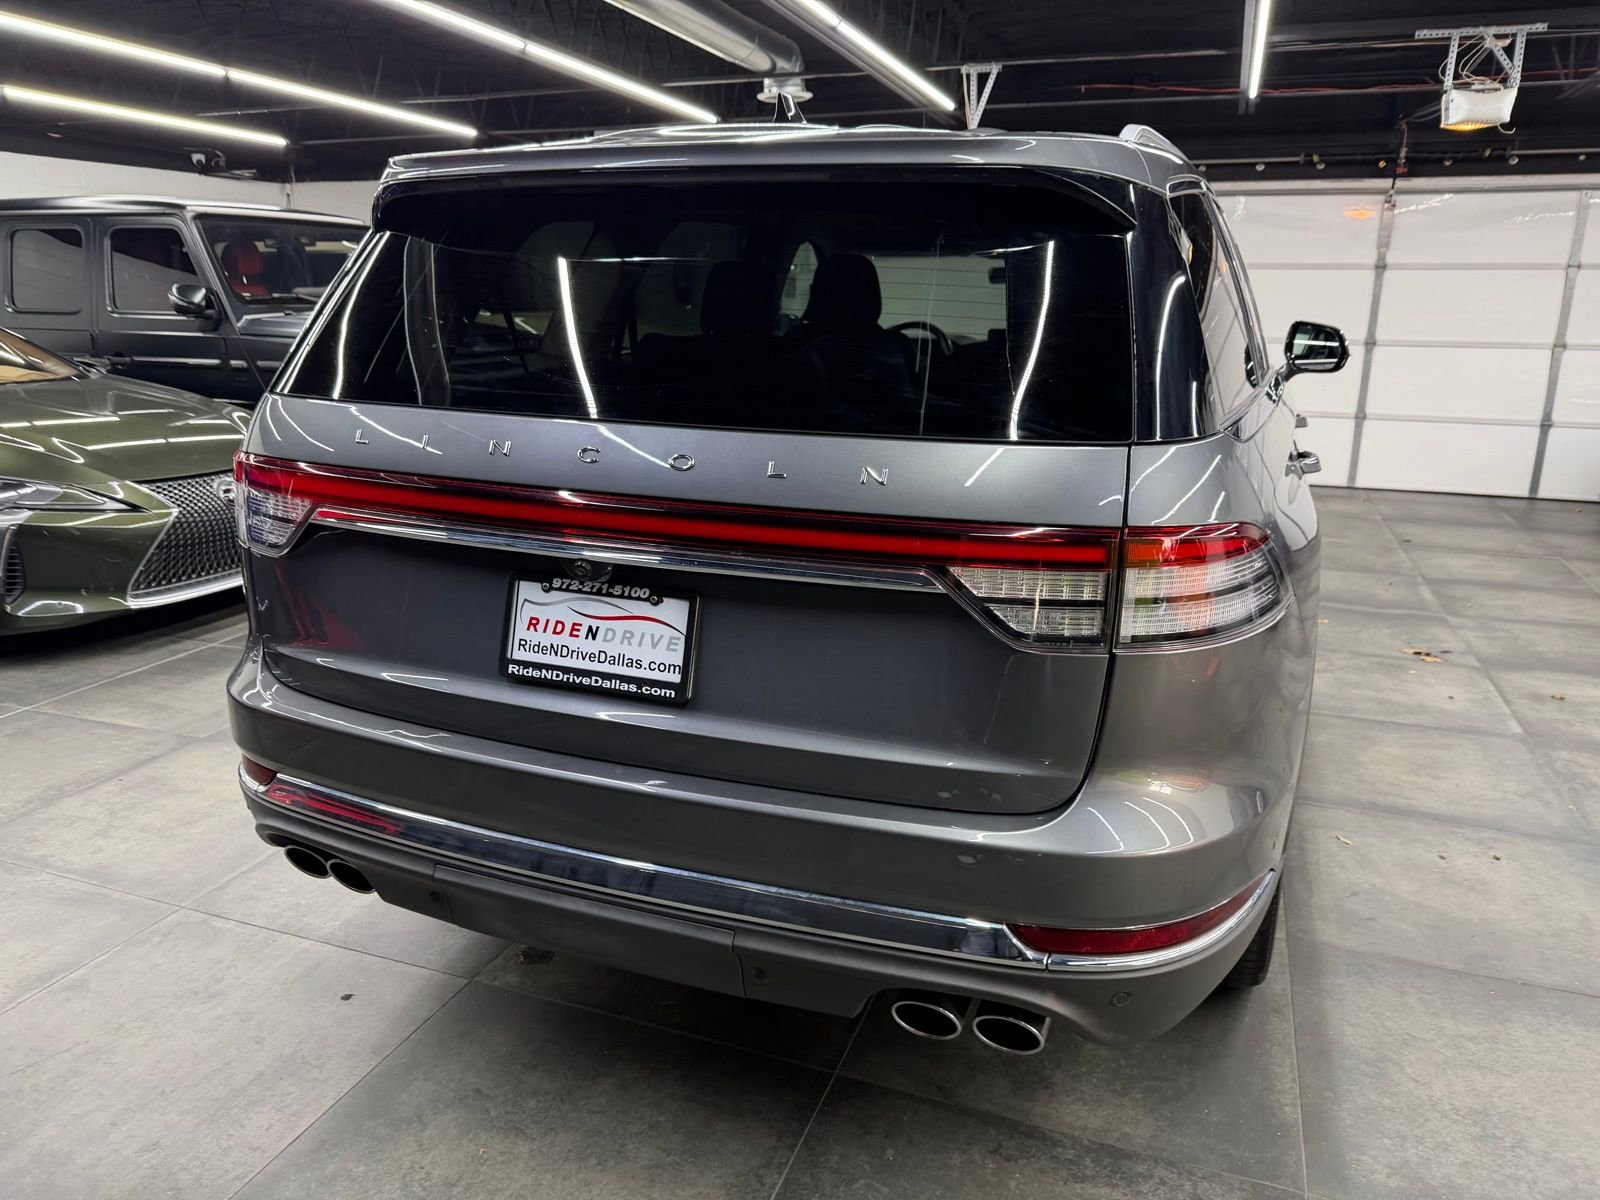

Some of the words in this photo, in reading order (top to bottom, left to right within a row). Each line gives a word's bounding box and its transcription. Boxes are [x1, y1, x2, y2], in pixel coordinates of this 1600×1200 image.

[355, 429, 888, 485] LINCOLN
[552, 578, 650, 599] 972-271-5100
[526, 616, 681, 653] RIDENDRIVE
[518, 638, 681, 675] RideNDriveDallas.com
[508, 664, 675, 699] RideNDriveDallas.com
